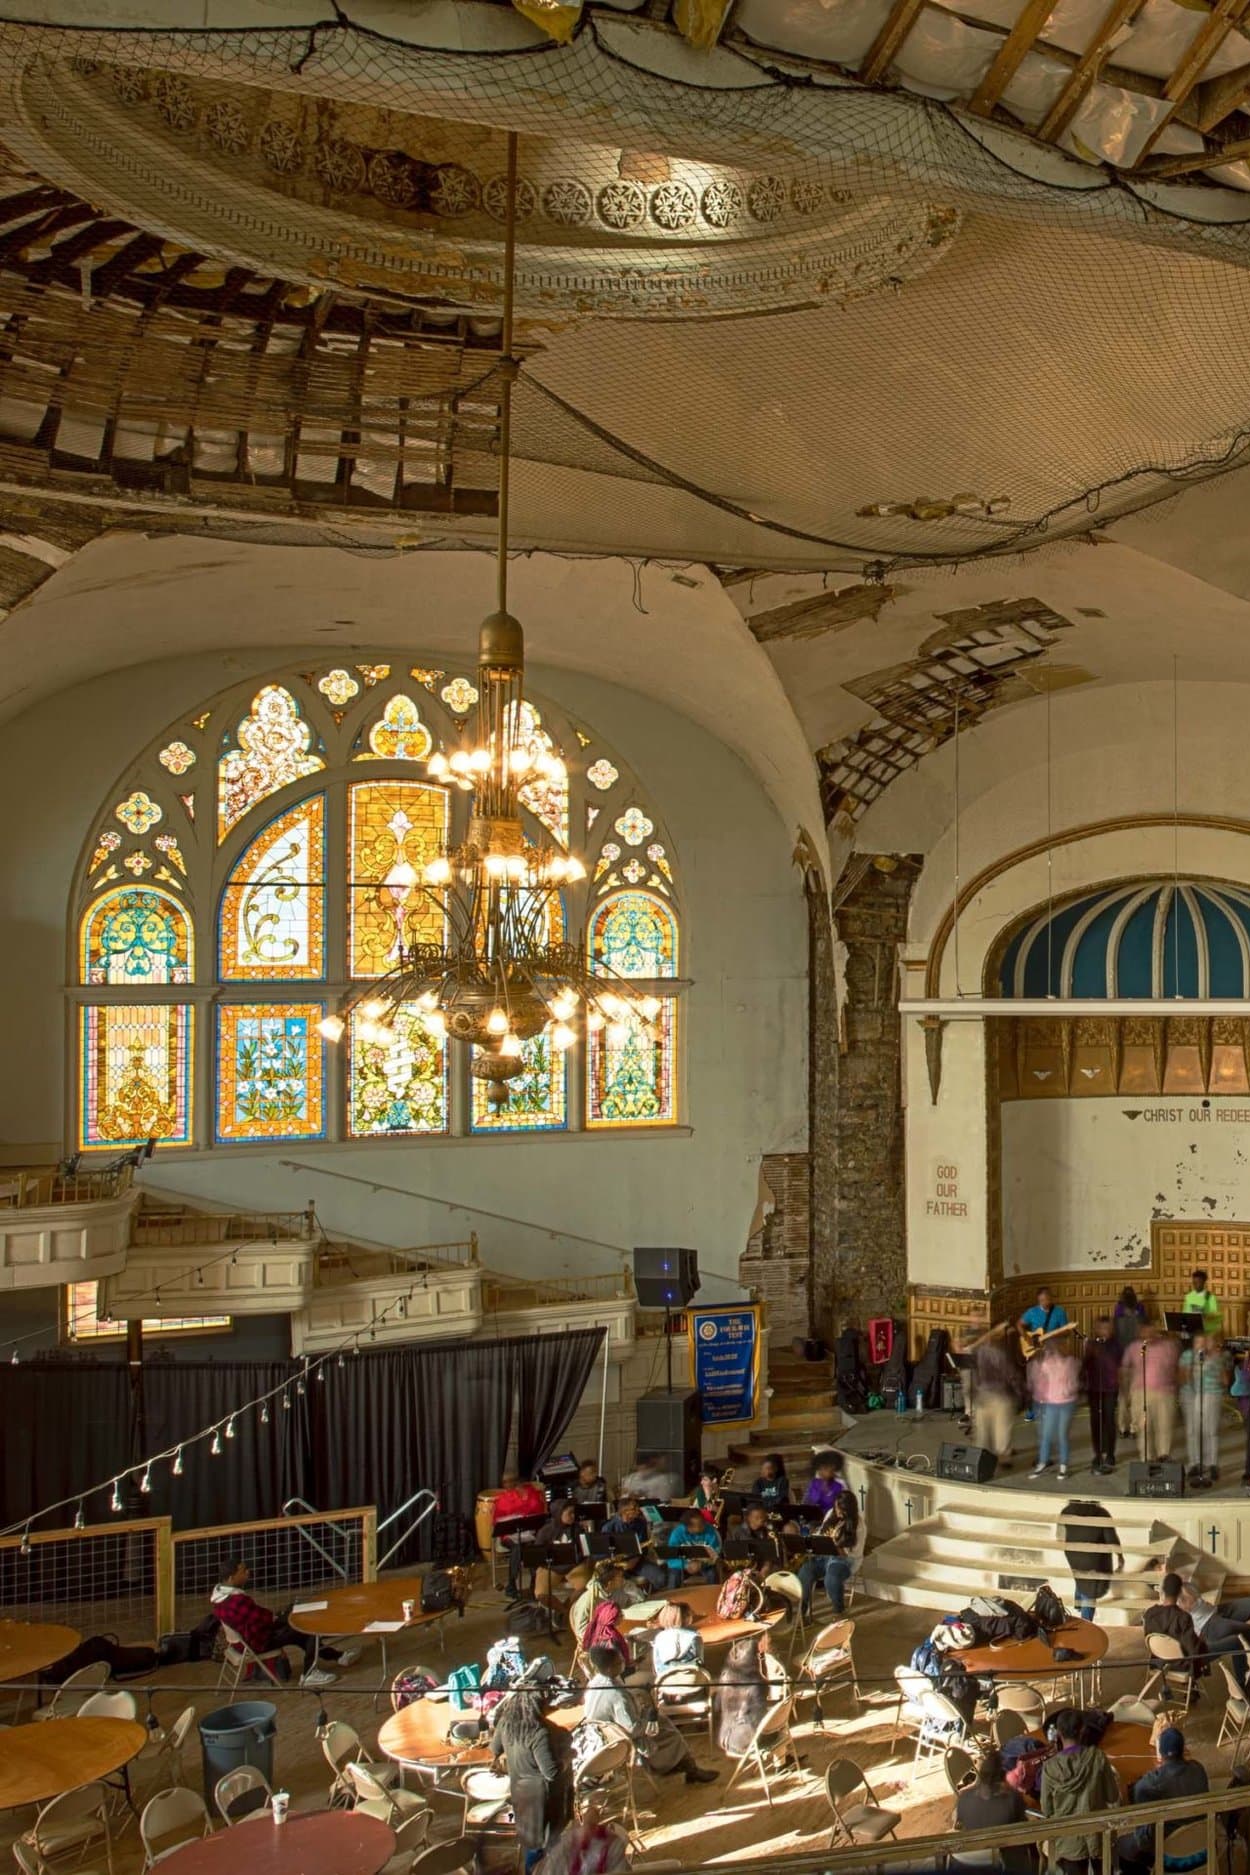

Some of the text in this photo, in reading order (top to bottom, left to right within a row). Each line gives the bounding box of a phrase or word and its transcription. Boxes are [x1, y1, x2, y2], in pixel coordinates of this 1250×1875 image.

[1143, 1109, 1183, 1122] CHRIST
[1188, 1109, 1211, 1122] OUR
[936, 1165, 958, 1179] GOD
[936, 1183, 958, 1198] OUR
[926, 1201, 968, 1216] FATHER
